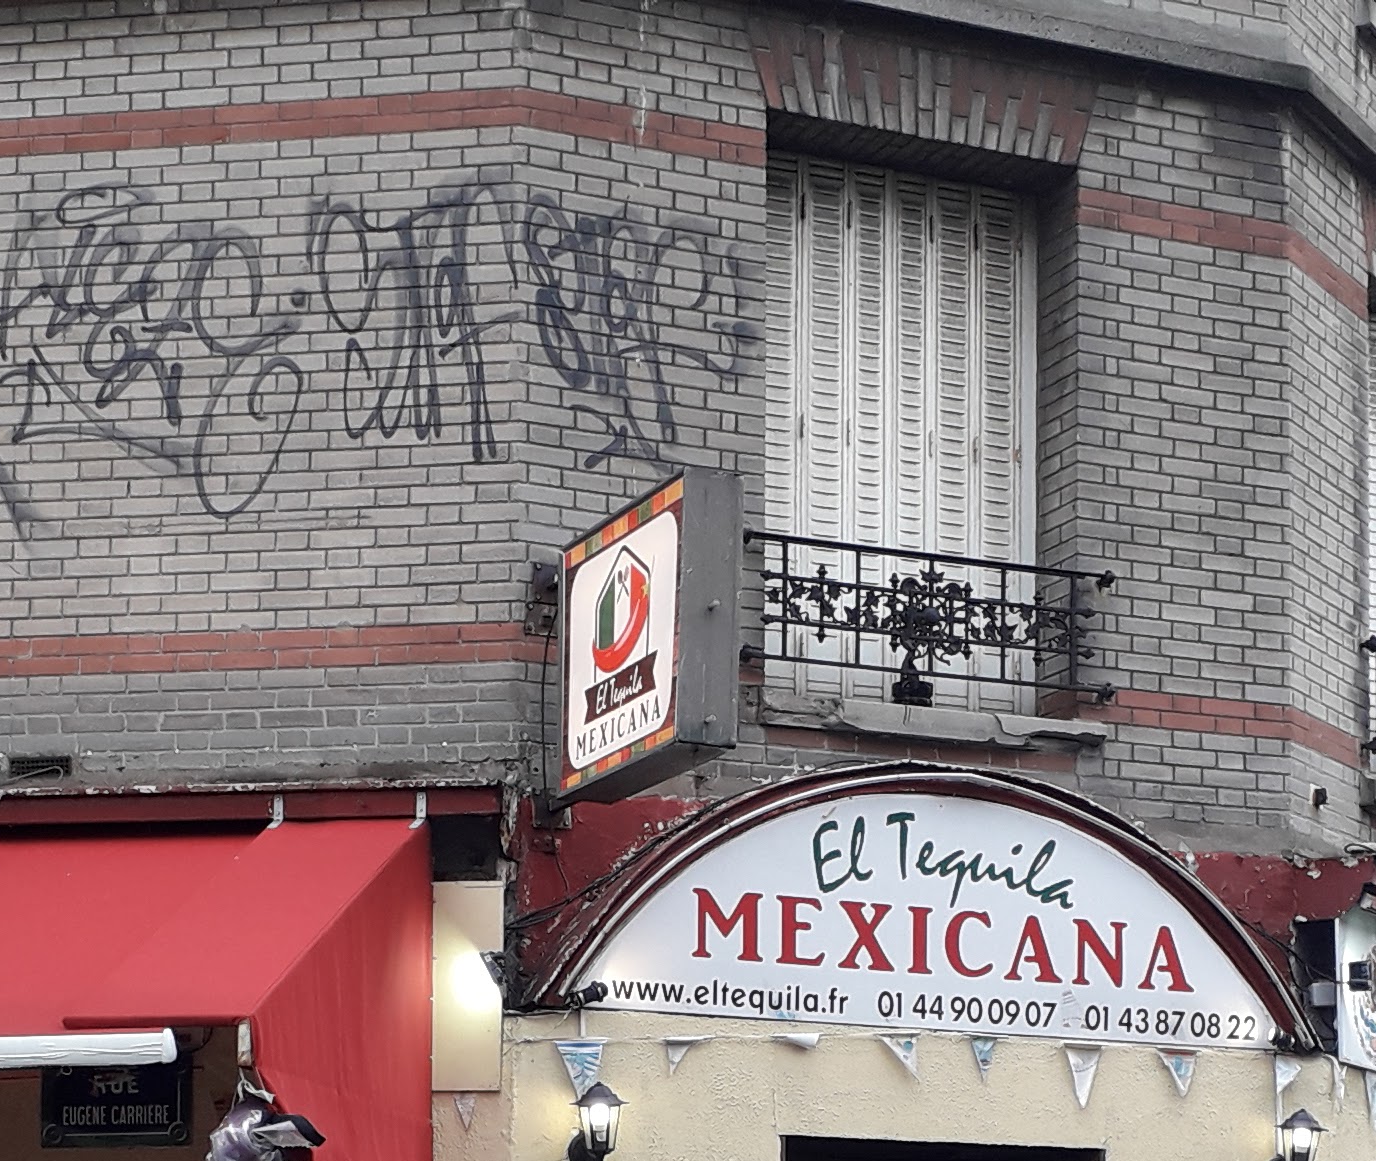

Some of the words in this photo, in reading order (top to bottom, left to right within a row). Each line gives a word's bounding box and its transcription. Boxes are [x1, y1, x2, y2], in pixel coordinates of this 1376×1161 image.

[595, 682, 609, 714] El
[610, 665, 642, 706] Tequila
[575, 694, 661, 760] MEXICANA
[813, 815, 873, 893] El
[886, 811, 1076, 909] Tequila
[691, 887, 1195, 993] MEXICANA
[612, 980, 849, 1014] www.eltequila.fr
[111, 1104, 170, 1125] CARRIERE
